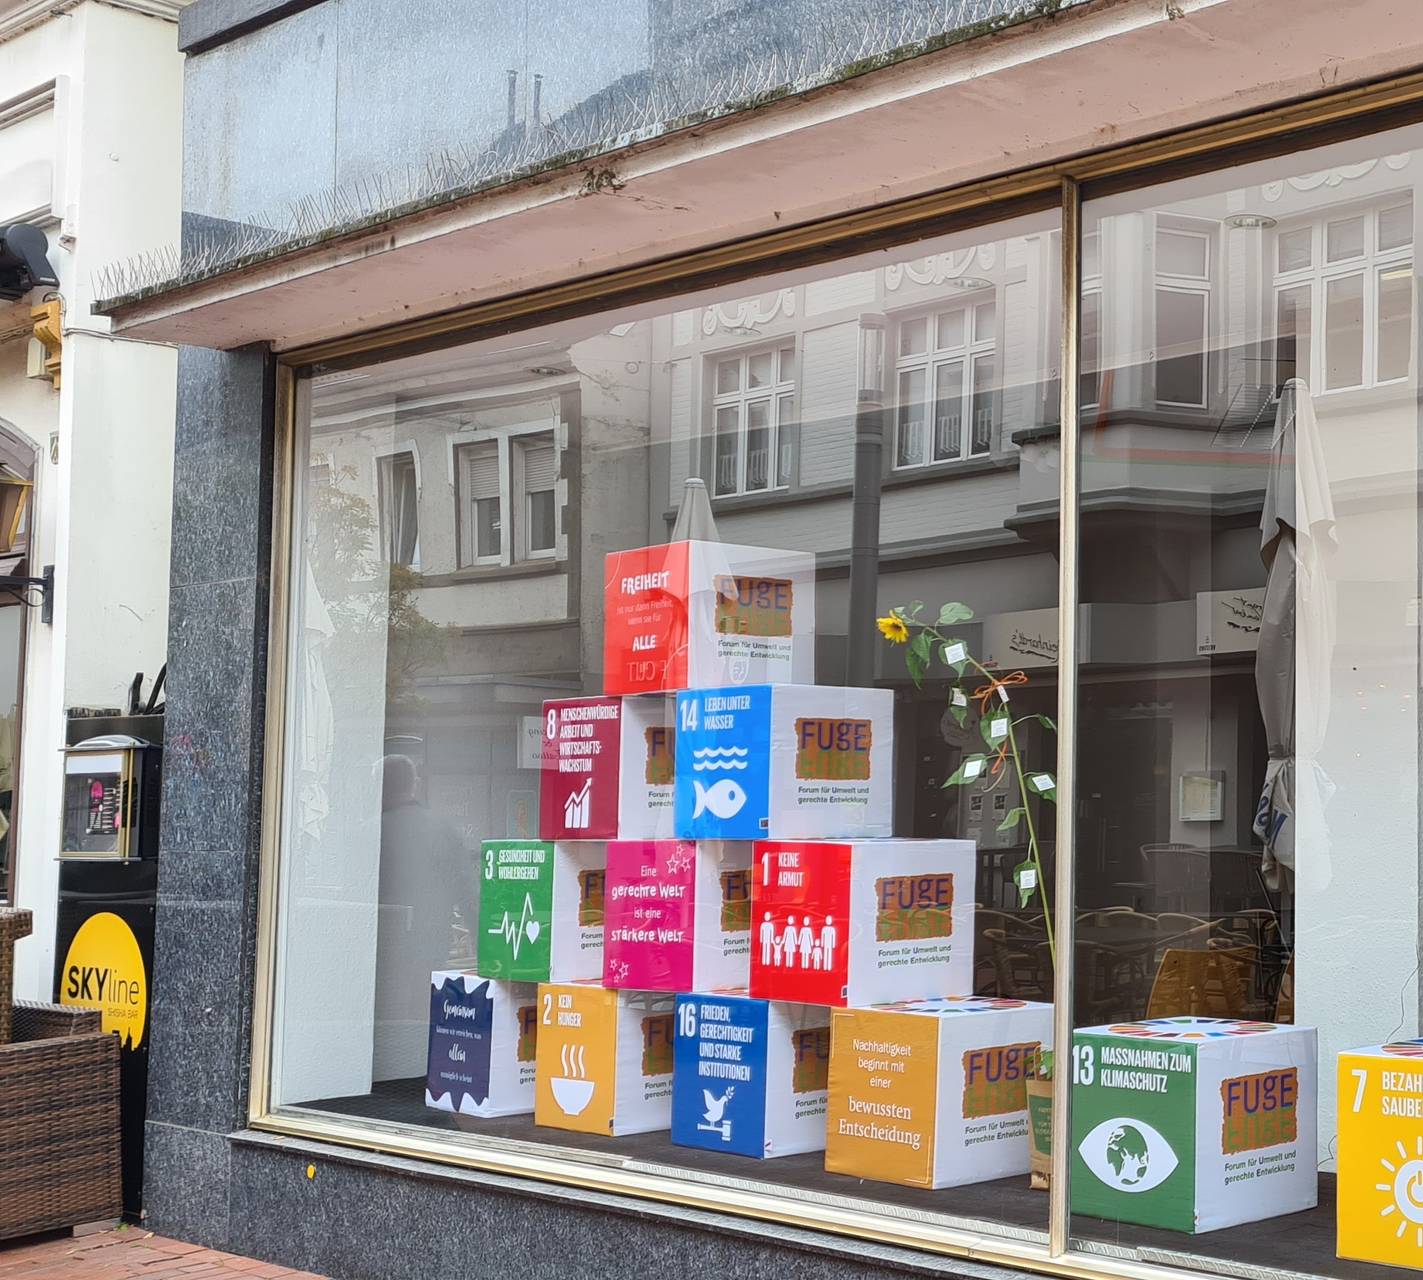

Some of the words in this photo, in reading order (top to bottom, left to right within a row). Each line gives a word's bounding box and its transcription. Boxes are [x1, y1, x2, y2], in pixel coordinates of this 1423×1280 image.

[621, 571, 670, 595] FREIHEIT
[632, 634, 656, 652] ALLE
[547, 709, 556, 740] 8
[560, 704, 618, 722] MENSCHENWÜRDIGE
[680, 699, 698, 732] 14
[704, 697, 726, 711] LEBEN
[727, 695, 750, 710] UNTER
[704, 714, 733, 730] WASSER
[560, 724, 580, 739] ARBEIT
[581, 724, 593, 738] UND
[559, 741, 602, 756] WIRTSCHAFTS-
[559, 758, 592, 773] WACHSTUM
[485, 849, 493, 880] 3
[498, 849, 533, 863] GESUNDHEIT
[533, 850, 545, 864] UND
[498, 866, 539, 880] WOHLERGEHEN
[641, 865, 657, 877] Eine
[761, 852, 770, 886] 1
[778, 852, 799, 868] KEINE
[778, 871, 804, 887] ARMUT
[634, 908, 643, 919] ist
[644, 908, 661, 919] eine
[611, 928, 655, 943] stärkere
[67, 965, 140, 1005] SKYline
[543, 994, 552, 1025] 2
[558, 995, 572, 1008] KEIN
[557, 1011, 581, 1028] HUNGER
[678, 1003, 695, 1038] 16
[700, 1004, 731, 1023] FRIEDEN,
[700, 1023, 753, 1043] GERECHTIGKEIT
[700, 1041, 715, 1058] UND
[715, 1042, 741, 1061] STARKE
[852, 1038, 911, 1058] Nachhaltigkeit
[699, 1061, 751, 1082] INSTITUTIONEN
[858, 1057, 887, 1074] beginnt
[889, 1060, 905, 1073] mit
[1073, 1045, 1094, 1086] 13
[1101, 1046, 1168, 1071] MASSNAHMEN
[1170, 1053, 1191, 1073] ZUM
[870, 1075, 892, 1089] einer
[1101, 1070, 1168, 1093] KLIMASCHUTZ
[1351, 1069, 1368, 1113] 7
[848, 1095, 912, 1121] bewussten
[838, 1118, 921, 1149] Entscheidung
[1224, 1160, 1246, 1172] Forum
[1247, 1157, 1257, 1168] für
[1258, 1154, 1283, 1166] Umwelt
[1284, 1150, 1296, 1160] und
[1224, 1171, 1254, 1186] gerechte
[1256, 1163, 1295, 1178] Entwicklung
